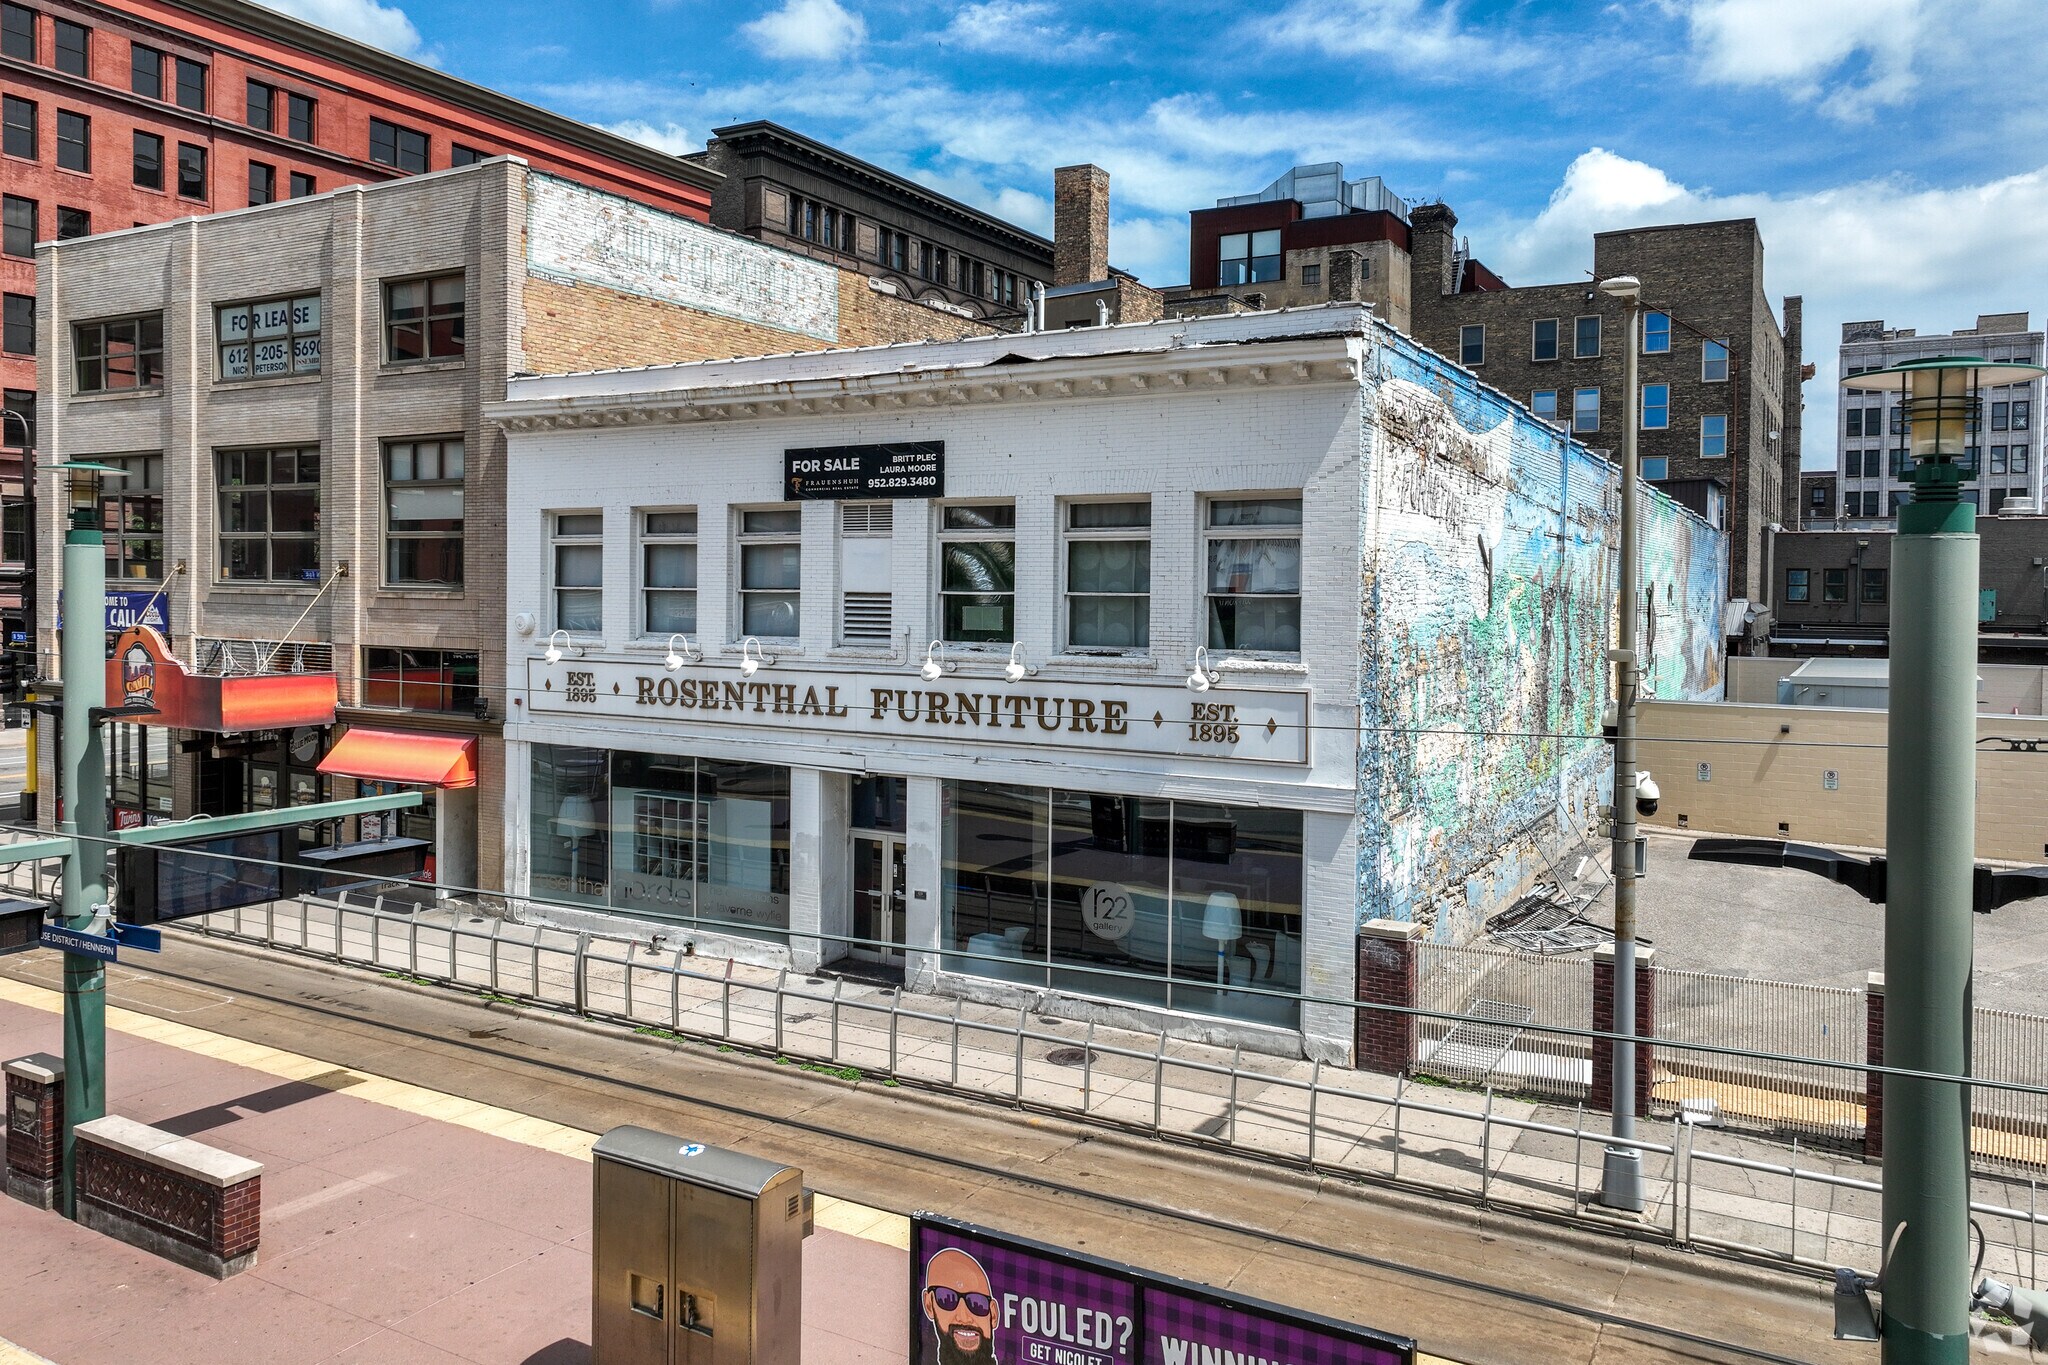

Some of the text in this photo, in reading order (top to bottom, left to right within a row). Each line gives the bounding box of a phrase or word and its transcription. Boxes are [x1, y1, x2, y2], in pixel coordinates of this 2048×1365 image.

[231, 306, 310, 332] FOR LEASE
[255, 361, 289, 373] PETERSON
[792, 457, 860, 473] FOR SALE
[892, 453, 937, 463] BRITT PLEC
[879, 463, 937, 474] LAURA MOORE
[867, 476, 937, 488] 952.829.3480
[119, 596, 129, 607] TO
[109, 608, 136, 628] CALL
[566, 671, 596, 687] EST.
[565, 686, 597, 703] 1895
[635, 676, 1128, 736] ROSENTHAL FURNITURE
[1190, 702, 1239, 723] EST.
[1188, 723, 1240, 744] 1895
[118, 811, 141, 827] Twins
[1092, 922, 1123, 934] gallery
[52, 933, 79, 947] DISTRICT
[82, 940, 114, 956] HENNEPIN
[1003, 1292, 1134, 1355] FOULED?
[1030, 1342, 1051, 1361] GET
[1160, 1335, 1295, 1365] WINN
